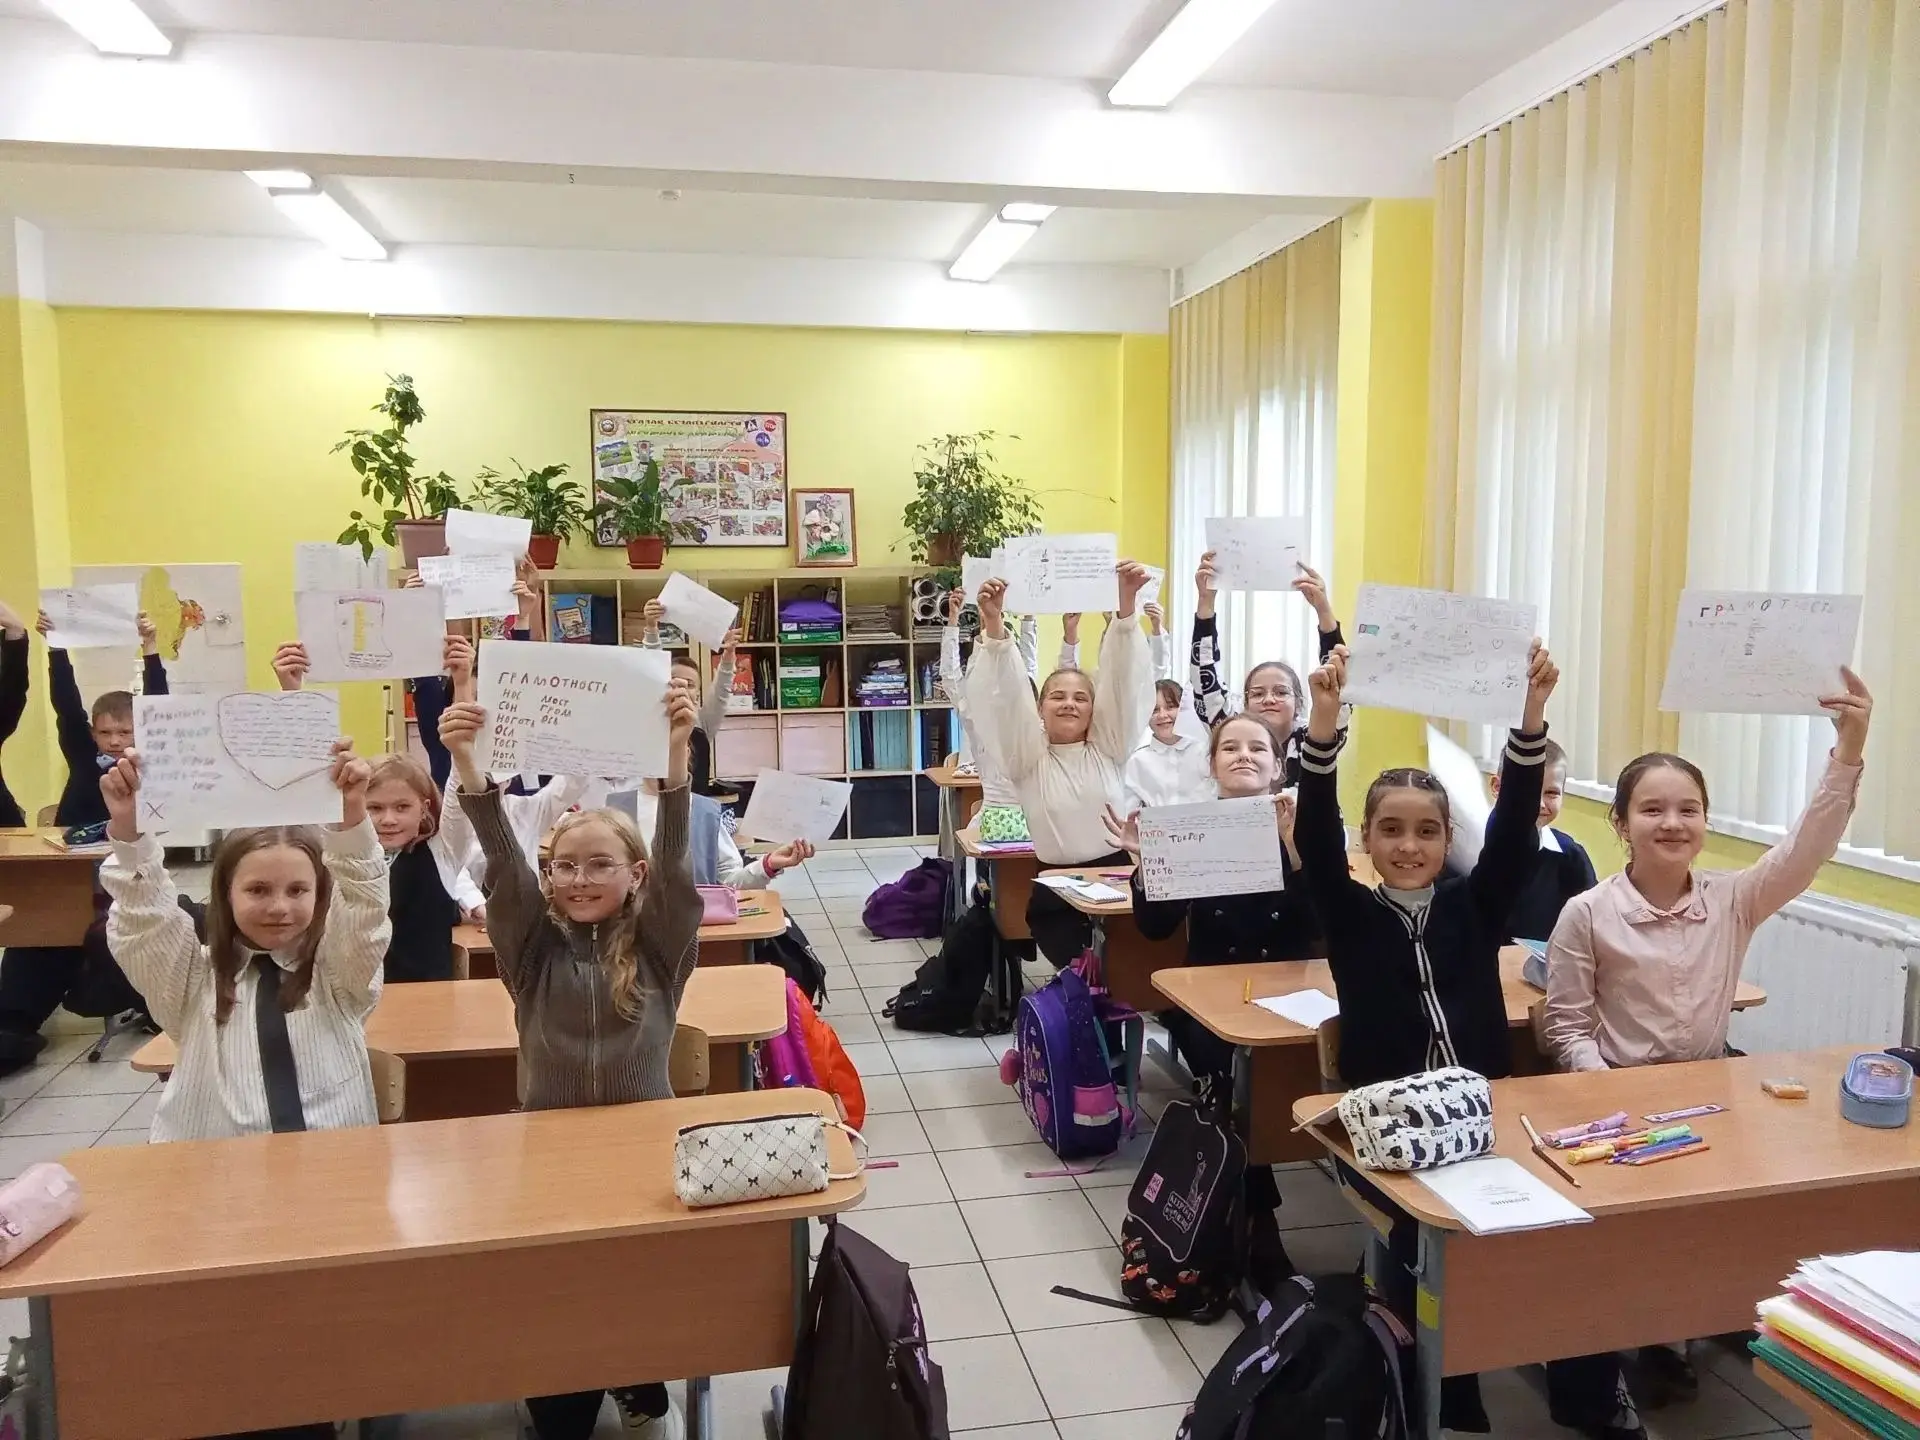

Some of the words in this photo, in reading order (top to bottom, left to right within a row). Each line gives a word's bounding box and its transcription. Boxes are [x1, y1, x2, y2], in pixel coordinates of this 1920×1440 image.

[498, 672, 608, 694] ГРАМОТНОСТЬ
[503, 688, 522, 700] НОС
[498, 701, 518, 713] СОН
[496, 713, 535, 728] НОГОТЬ
